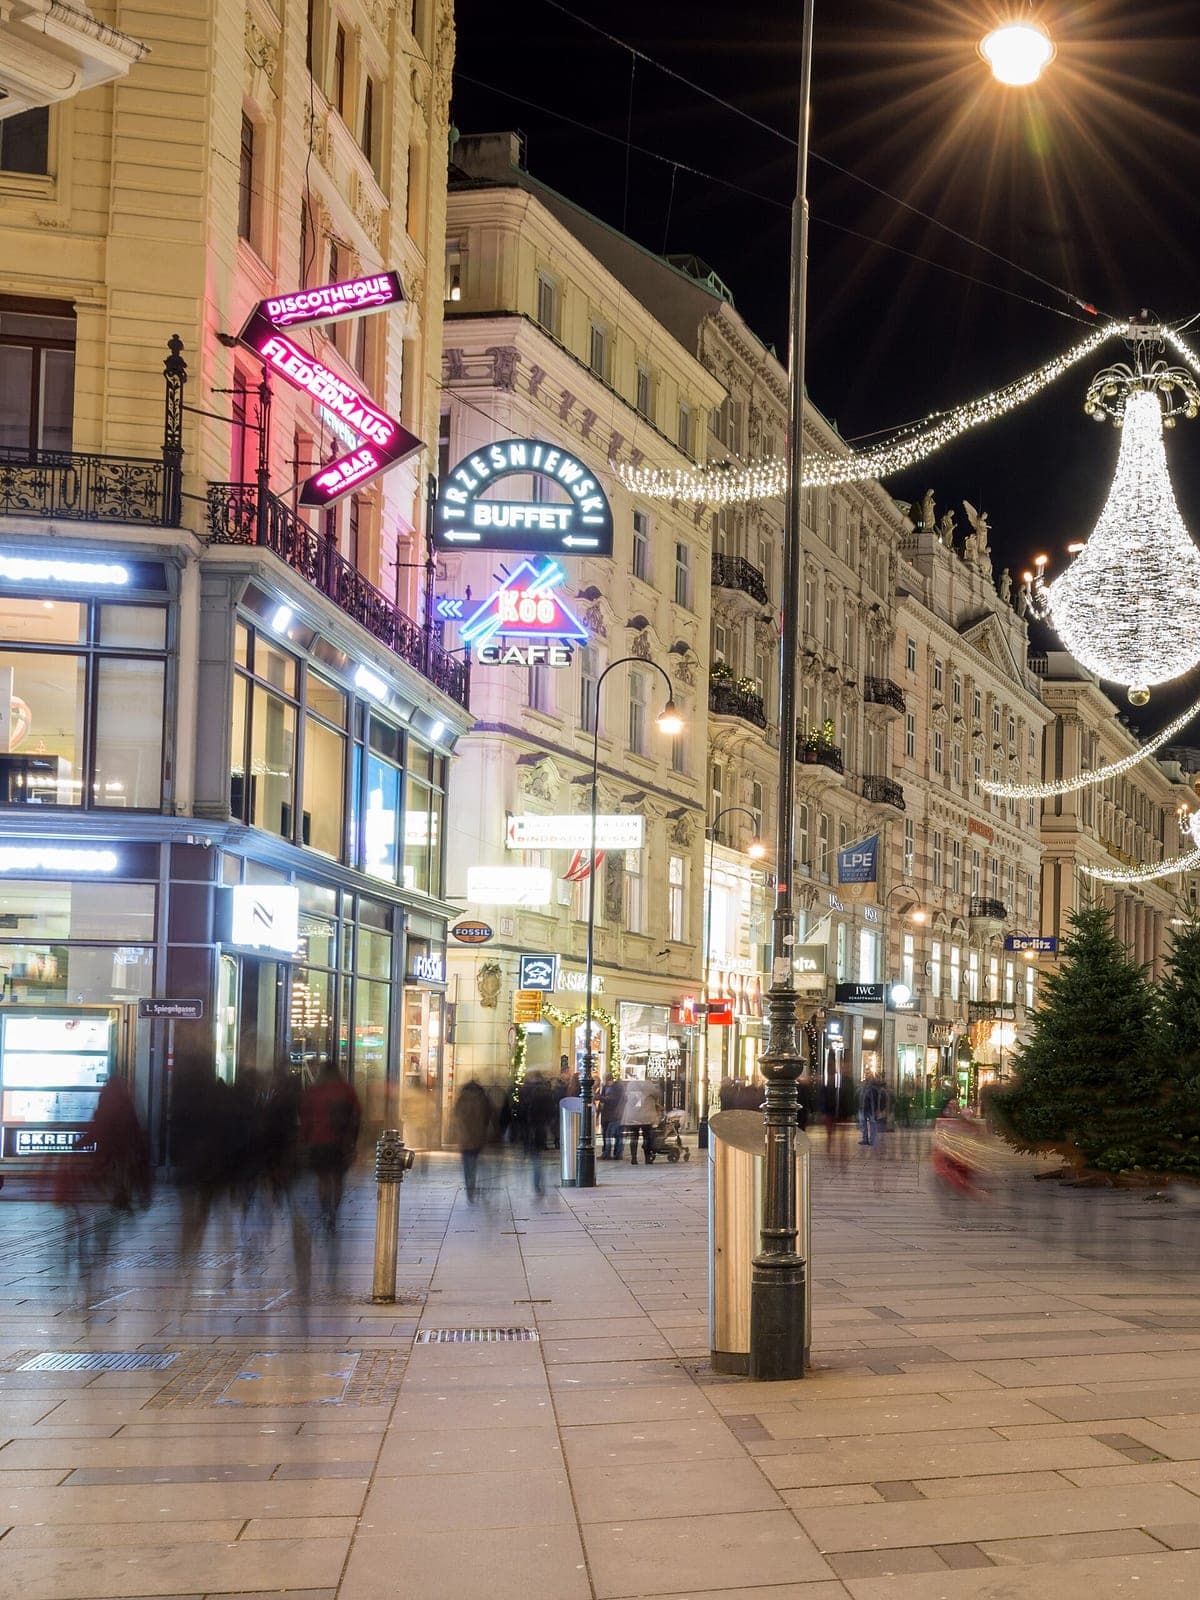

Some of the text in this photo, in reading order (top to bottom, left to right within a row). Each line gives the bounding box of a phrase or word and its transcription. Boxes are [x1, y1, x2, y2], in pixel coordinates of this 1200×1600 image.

[267, 276, 391, 317] DISCOTHEQUE
[260, 339, 392, 445] FLEDERMAUS
[338, 450, 375, 475] BAR
[444, 445, 604, 524] TRZEŚNIEWSKI
[474, 504, 572, 530] BUFFET
[477, 646, 572, 667] CAFE
[843, 852, 873, 868] LPE
[455, 928, 490, 936] FOSSIL
[1013, 939, 1051, 949] Berlitz
[417, 955, 442, 981] FOSSIL
[855, 986, 875, 995] IWC
